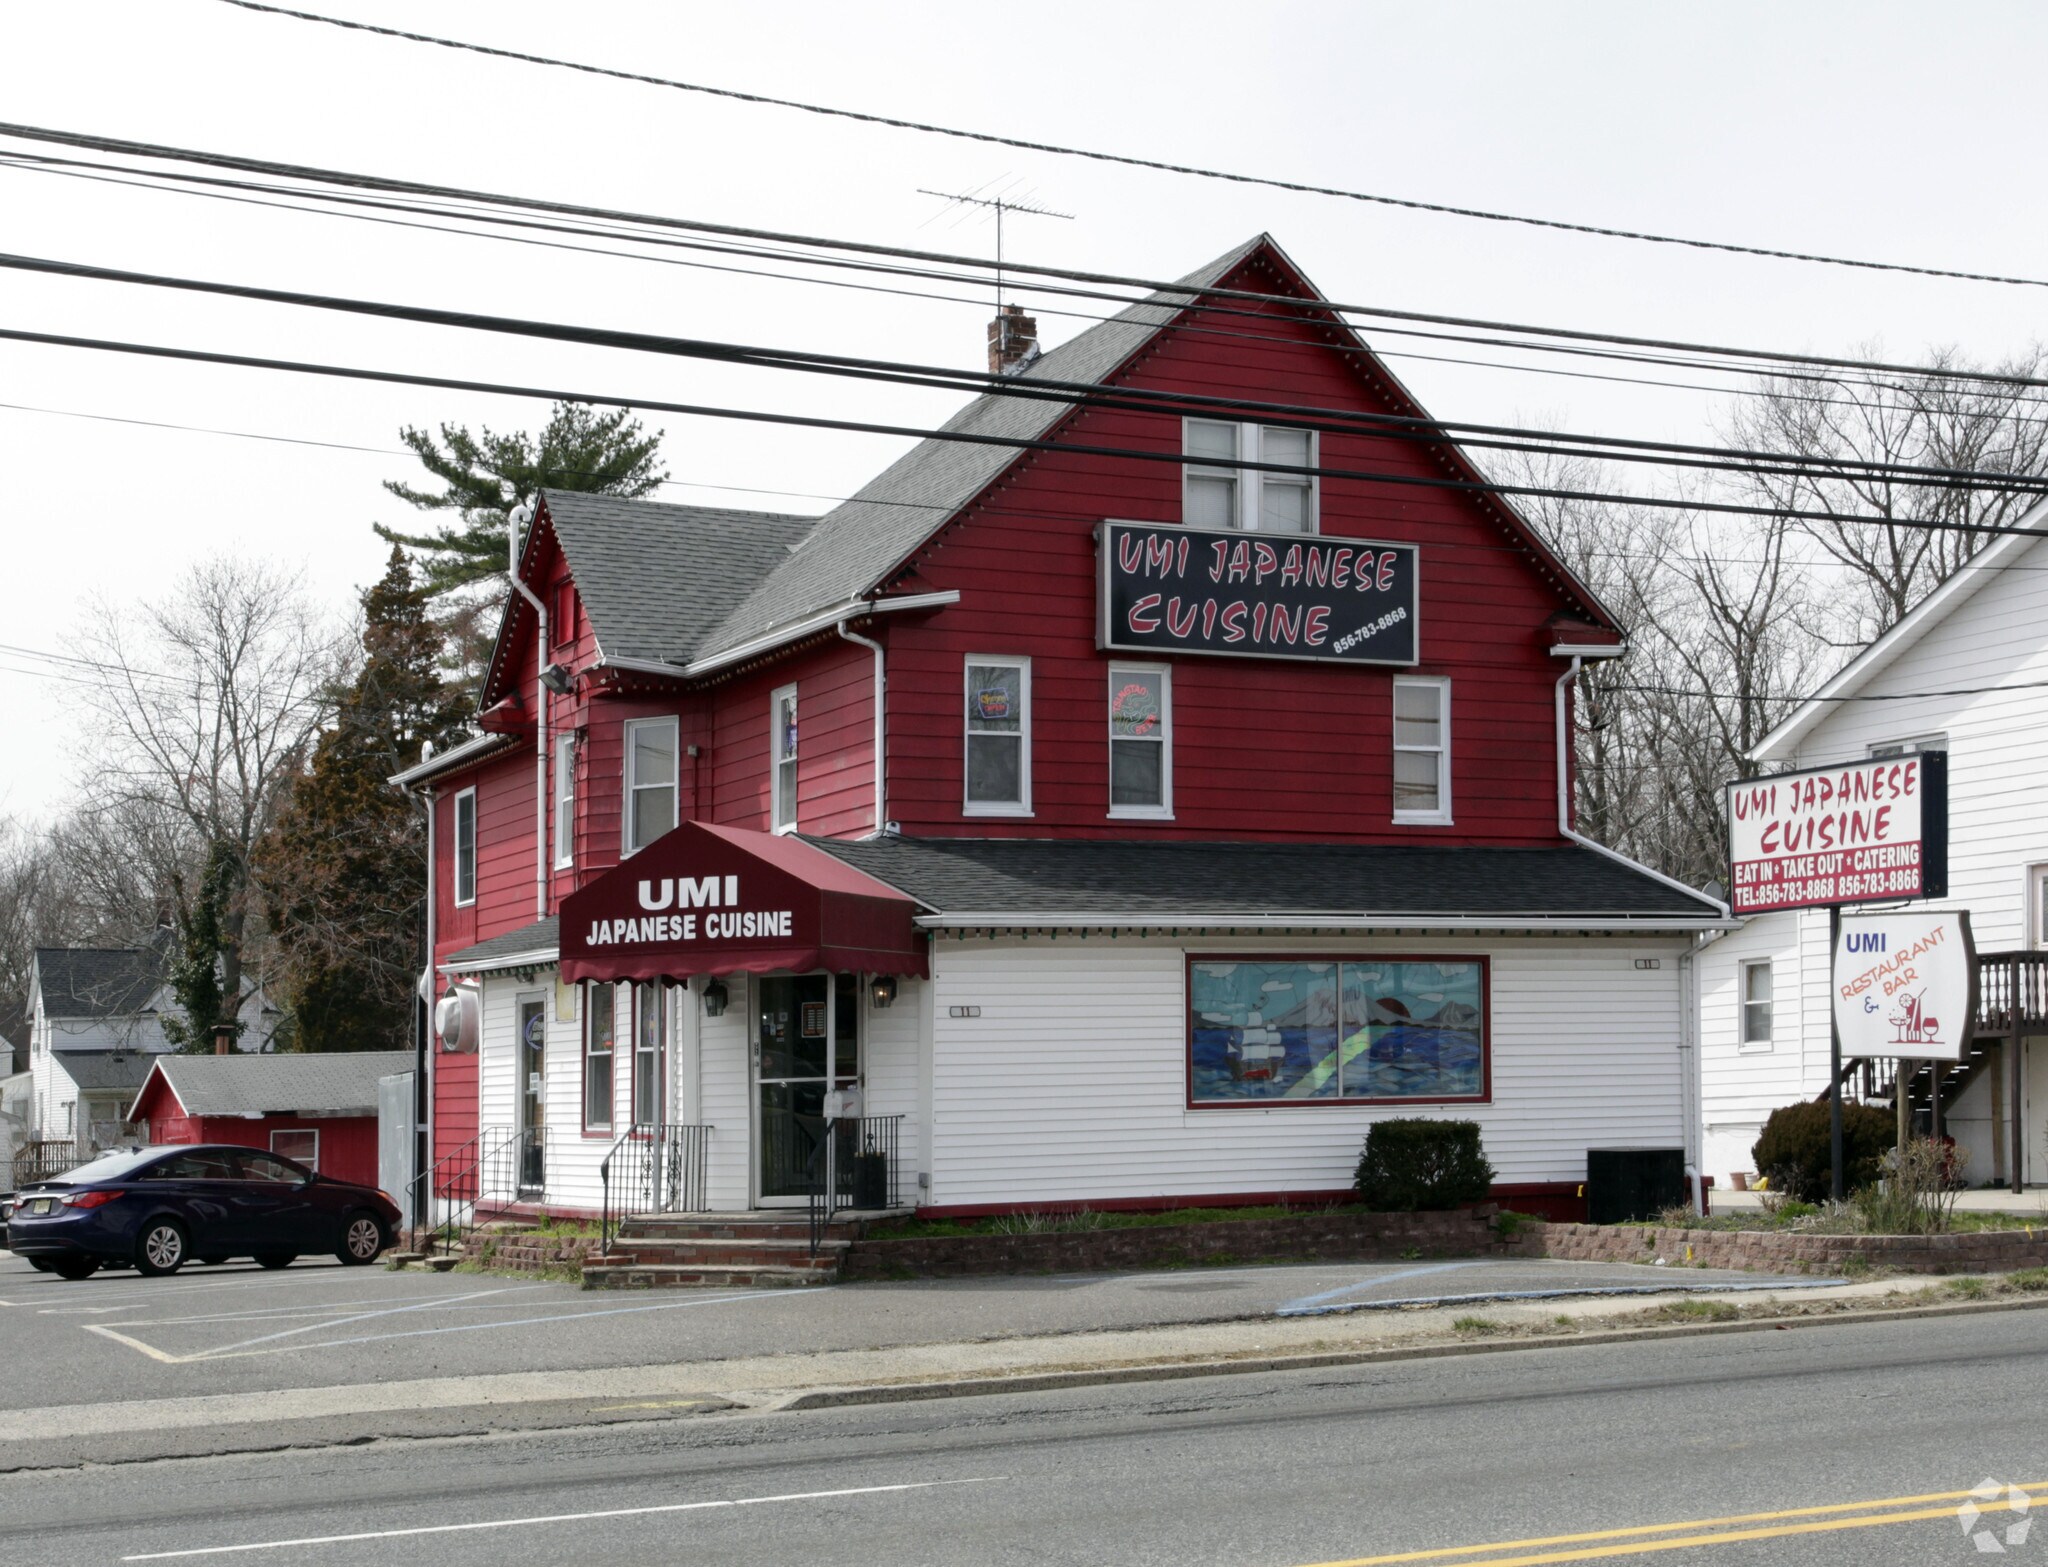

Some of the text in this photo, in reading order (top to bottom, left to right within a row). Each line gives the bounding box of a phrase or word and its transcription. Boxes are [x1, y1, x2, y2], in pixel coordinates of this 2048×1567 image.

[1119, 532, 1397, 592] UMI JAPANESE
[1128, 593, 1331, 646] CUISINE
[1333, 606, 1407, 654] 856-783-8868
[1735, 761, 1917, 821] UMI JAPANESE
[1760, 805, 1891, 854] CUISINE
[1735, 843, 1919, 884] EAT IN TAKE OUT CATERING
[1838, 868, 1919, 898] 856-783-8866
[638, 875, 738, 910] UMI
[586, 910, 792, 946] JAPANESE CUISINE
[1846, 933, 1886, 953] UMI
[1840, 926, 1944, 1001] RESTAURANT
[1883, 967, 1919, 996] BAR
[1864, 996, 1879, 1014] &
